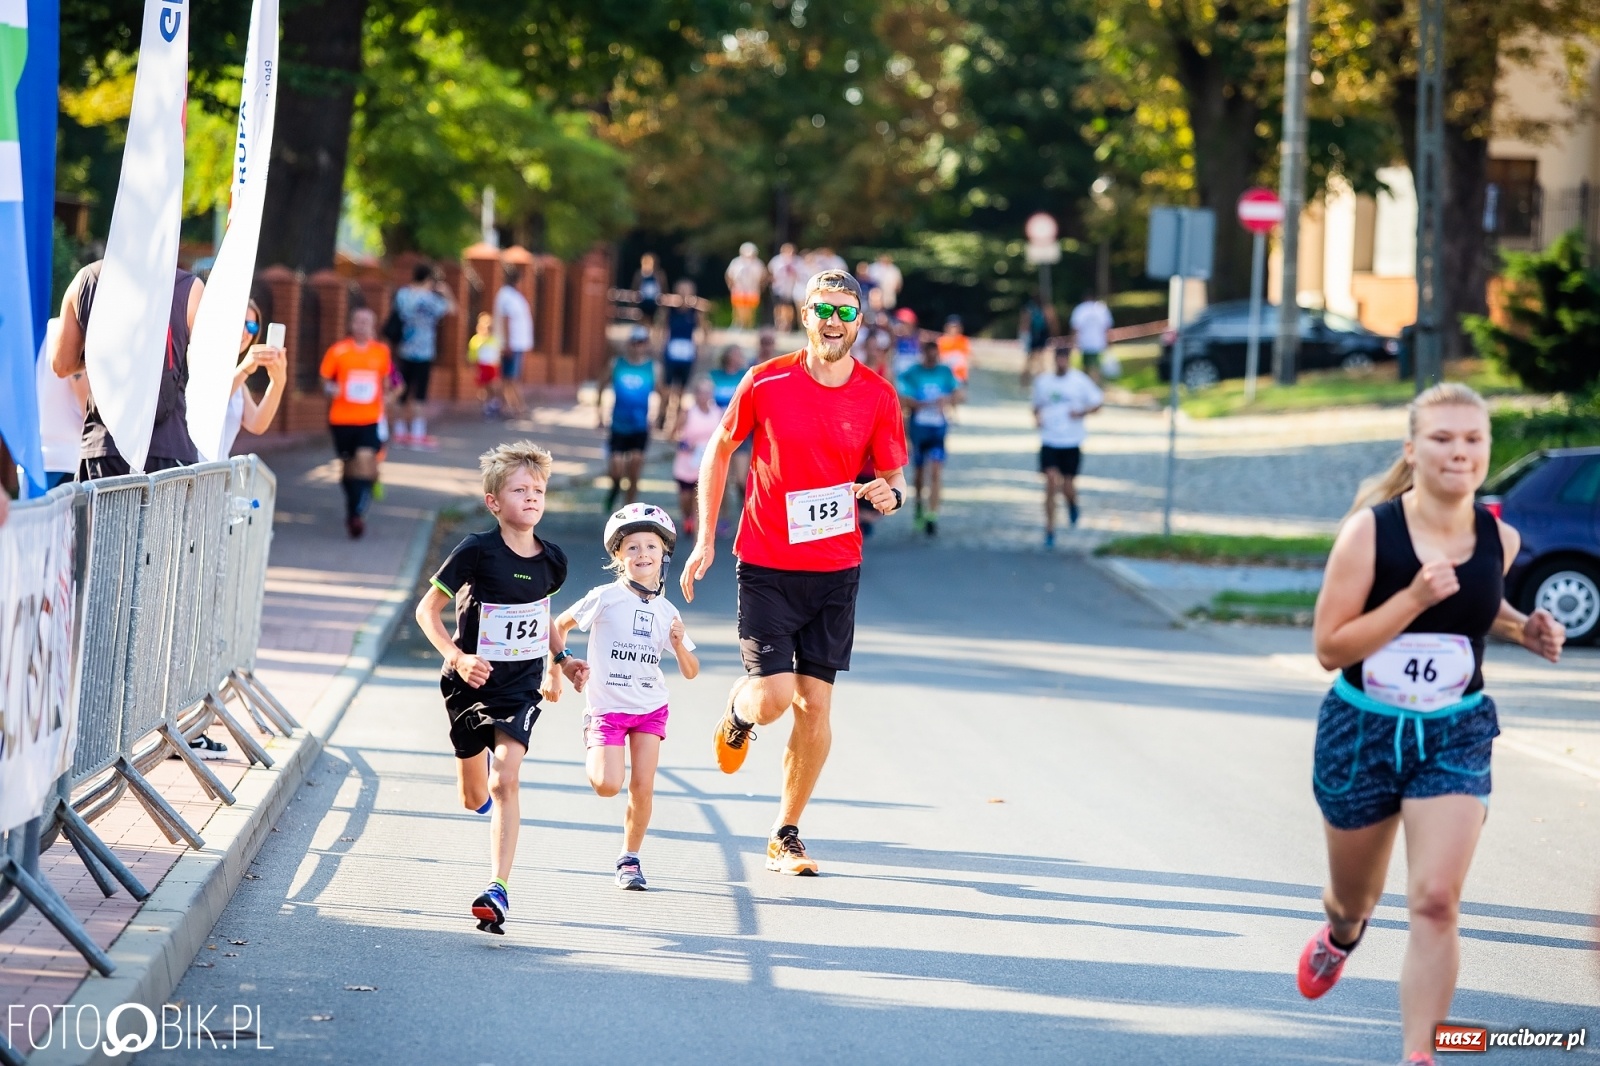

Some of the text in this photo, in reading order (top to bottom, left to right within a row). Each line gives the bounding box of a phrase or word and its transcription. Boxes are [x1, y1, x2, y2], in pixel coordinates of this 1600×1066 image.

[808, 500, 838, 522] 153
[504, 618, 538, 640] 152
[610, 649, 637, 662] RUN
[1403, 658, 1438, 682] 46
